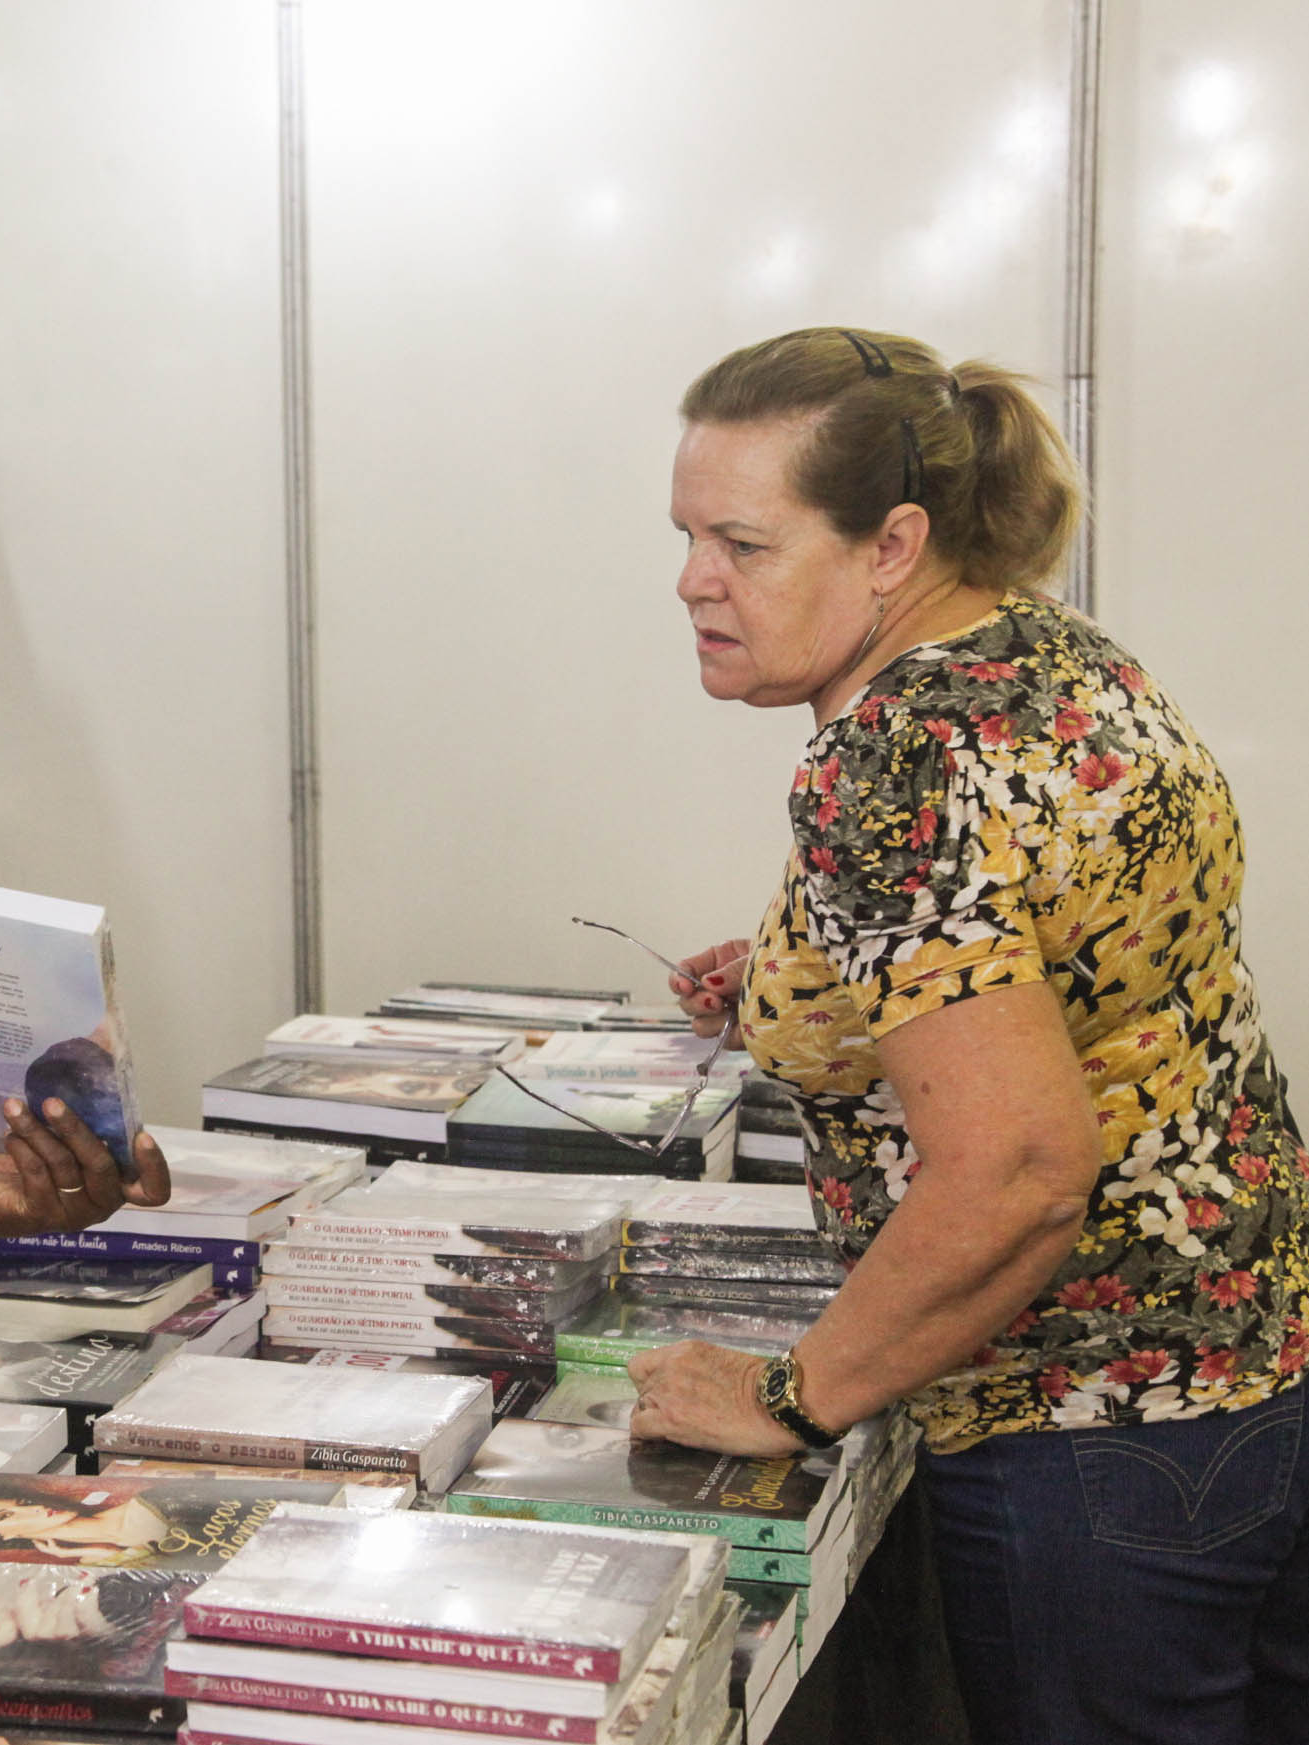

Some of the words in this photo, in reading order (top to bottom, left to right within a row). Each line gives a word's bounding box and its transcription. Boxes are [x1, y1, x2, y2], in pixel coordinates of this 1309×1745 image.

[383, 1227, 417, 1239] TIMO
[417, 1229, 451, 1239] PORTAL
[78, 1234, 108, 1251] limites
[132, 1241, 168, 1252] Amadeu
[171, 1243, 202, 1254] Ribeiro
[297, 1252, 338, 1263] GUARDÃO
[356, 1255, 388, 1266] STIMO
[289, 1283, 333, 1294] GUARDIÃO
[334, 1287, 347, 1295] DO
[348, 1285, 380, 1297] SÉTIMO
[382, 1290, 414, 1300] PORTAL
[297, 1315, 340, 1326] GUARDIÃO
[343, 1319, 355, 1327] DO
[357, 1317, 389, 1328] SÉTIMO
[391, 1321, 424, 1331] PORTAL
[28, 1334, 114, 1397] destino
[128, 1431, 202, 1452] Vencendo
[212, 1444, 220, 1453] o
[230, 1444, 296, 1462] passado
[311, 1447, 340, 1462] Zibia
[342, 1449, 407, 1469] Gasparetto
[158, 1500, 242, 1557] Laços
[595, 1511, 628, 1522] ZIBIA
[634, 1514, 718, 1529] GASPARETTO
[347, 1629, 359, 1643] A
[360, 1631, 406, 1649] VIDA
[408, 1635, 456, 1655] SABE
[459, 1645, 473, 1657] O
[476, 1645, 513, 1662] QUE
[515, 1649, 551, 1667] FAZ
[200, 1678, 229, 1692] IBIA
[323, 1691, 335, 1706] A
[338, 1693, 380, 1711] VIDA
[385, 1699, 430, 1716] SABE
[433, 1704, 447, 1718] O
[450, 1706, 489, 1723] QUE
[491, 1710, 526, 1728] FAZ
